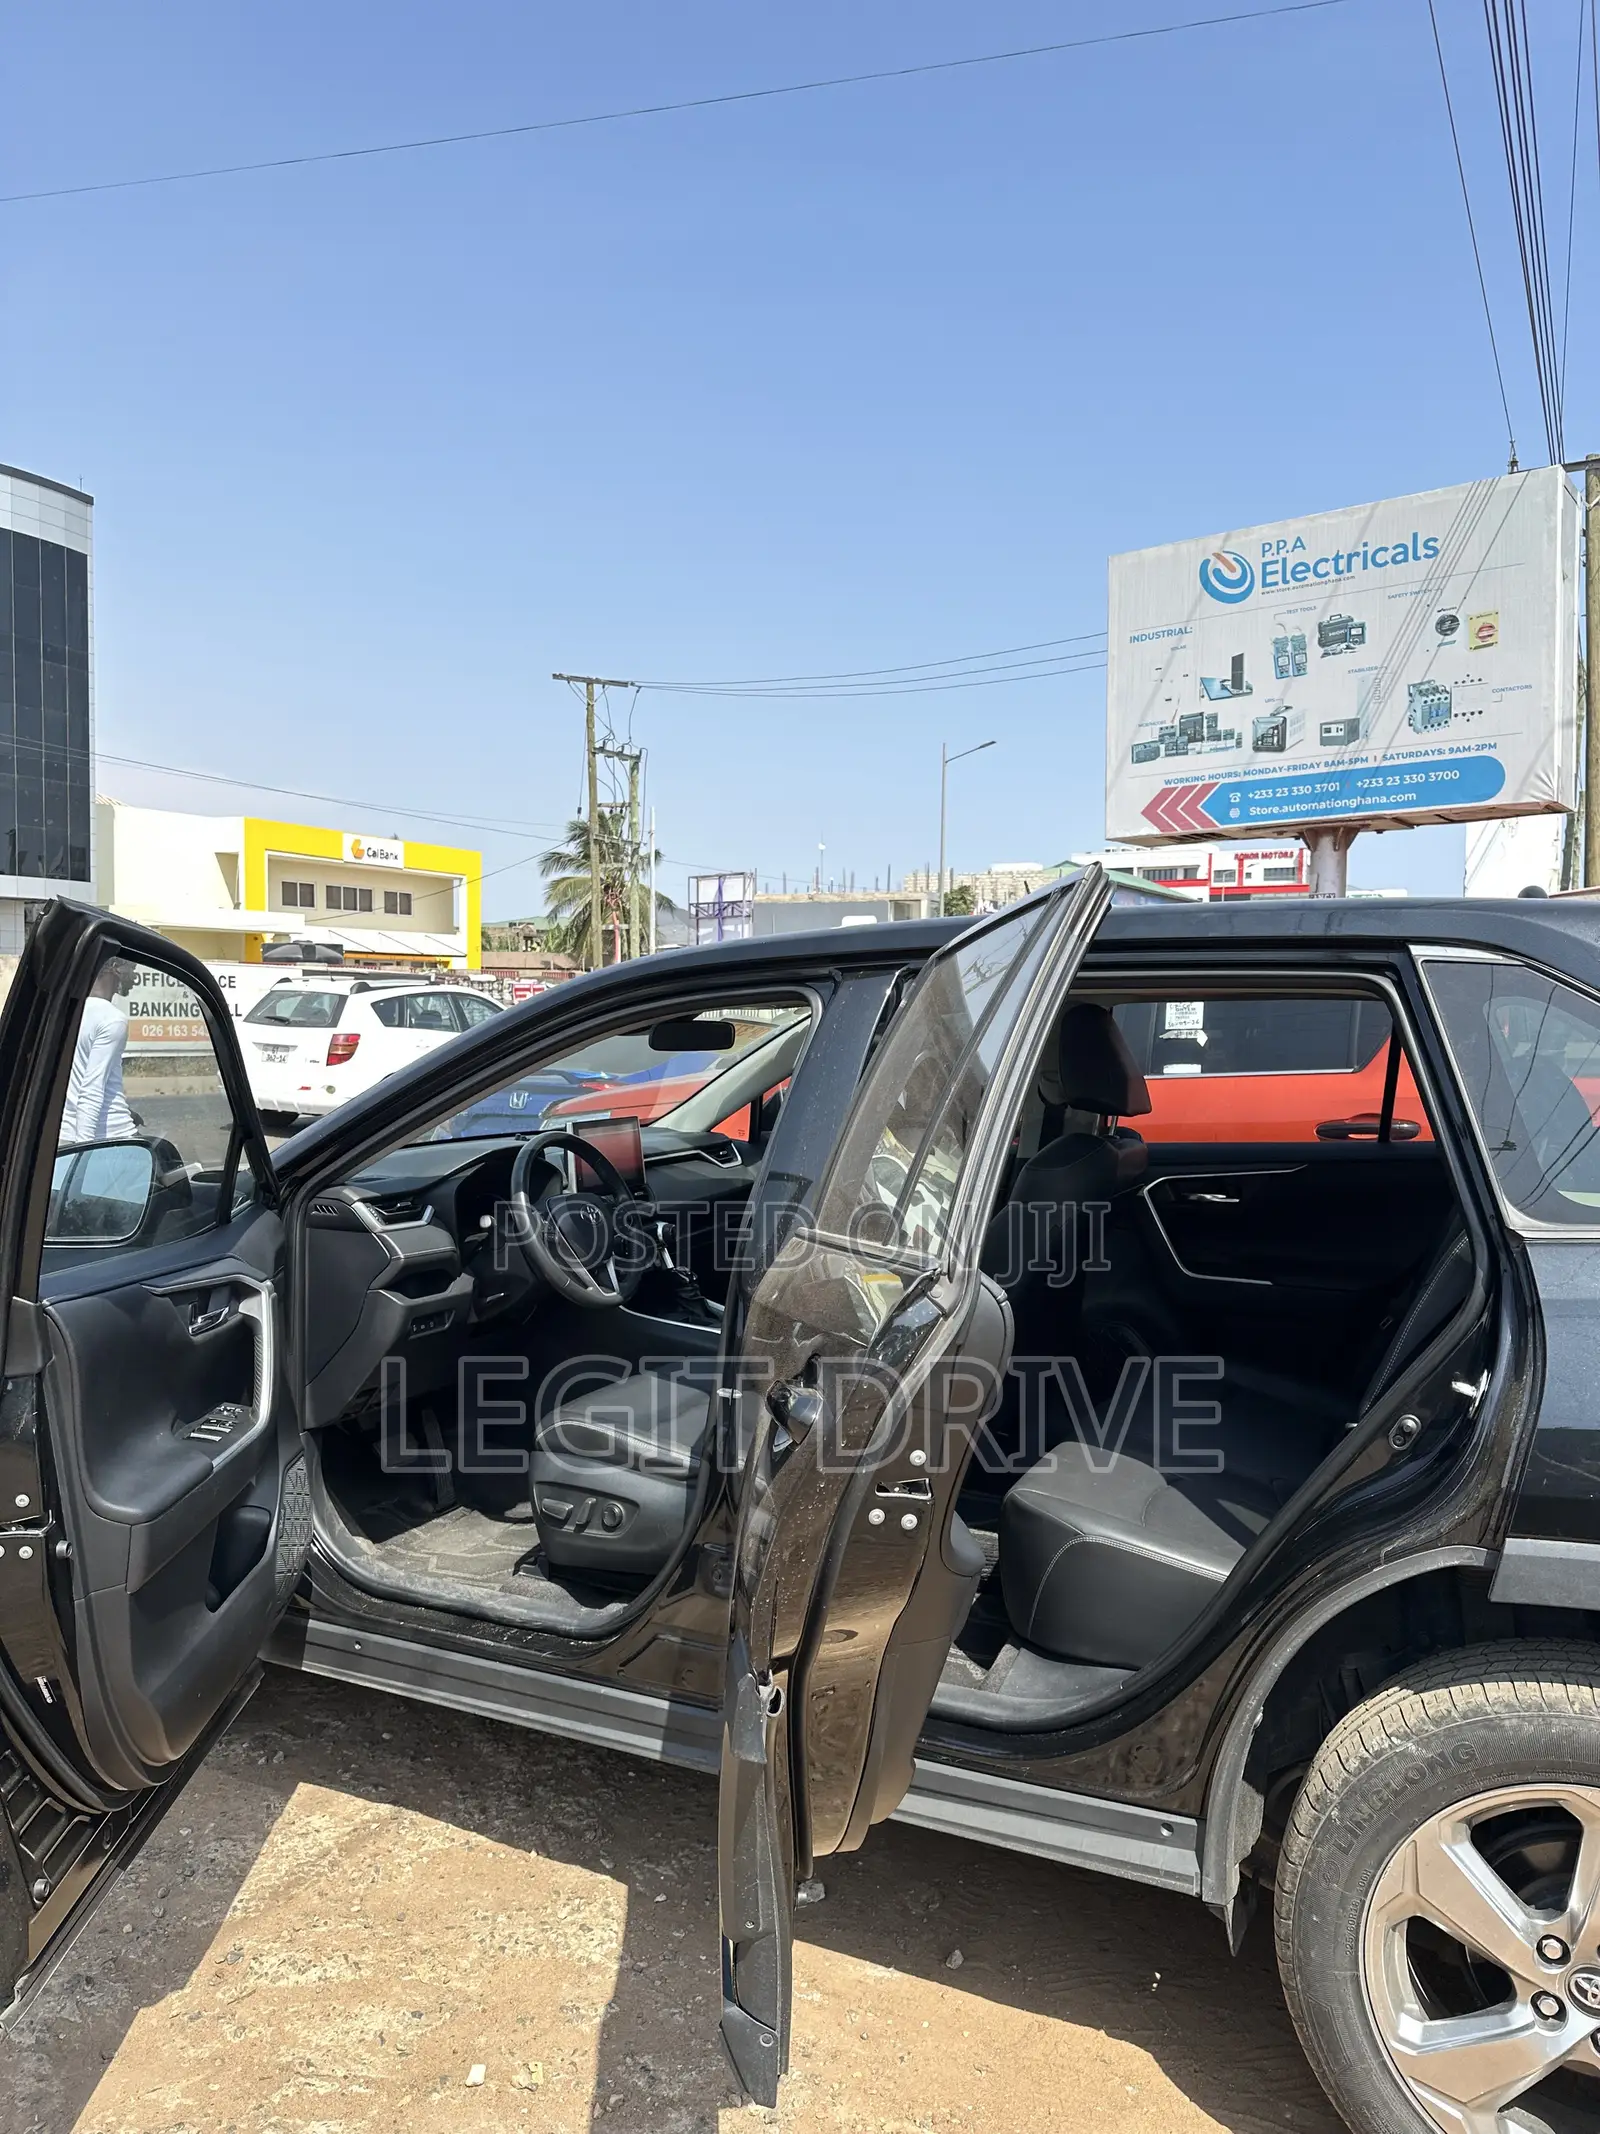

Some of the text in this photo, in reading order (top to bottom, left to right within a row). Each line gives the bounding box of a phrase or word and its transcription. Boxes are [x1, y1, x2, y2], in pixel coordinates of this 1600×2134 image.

[1261, 536, 1306, 558] P.P.A
[1261, 532, 1440, 588] Electricals
[1388, 591, 1409, 600] SAFETY
[1300, 605, 1317, 613] TOOLS
[1129, 626, 1193, 644] INDUSTRIAL:
[1347, 665, 1378, 675] STABILIZER
[1492, 684, 1533, 694] CONTACTORS
[1164, 742, 1498, 786] WORKING HOURS: MONDAY-FRIDAY 8AM-5PM SATURDAYS: 9AM-2PM
[1356, 770, 1460, 789] +233 23 330 3700
[1248, 782, 1340, 800] +233 23 330 3701
[1249, 791, 1417, 816] Store.automationghana.com
[1261, 850, 1294, 860] MOTORS
[182, 990, 189, 999] &
[129, 1001, 200, 1017] BANKING
[142, 1025, 163, 1036] 026
[167, 1025, 188, 1036] 163
[1331, 1741, 1478, 1857] LINGLONG
